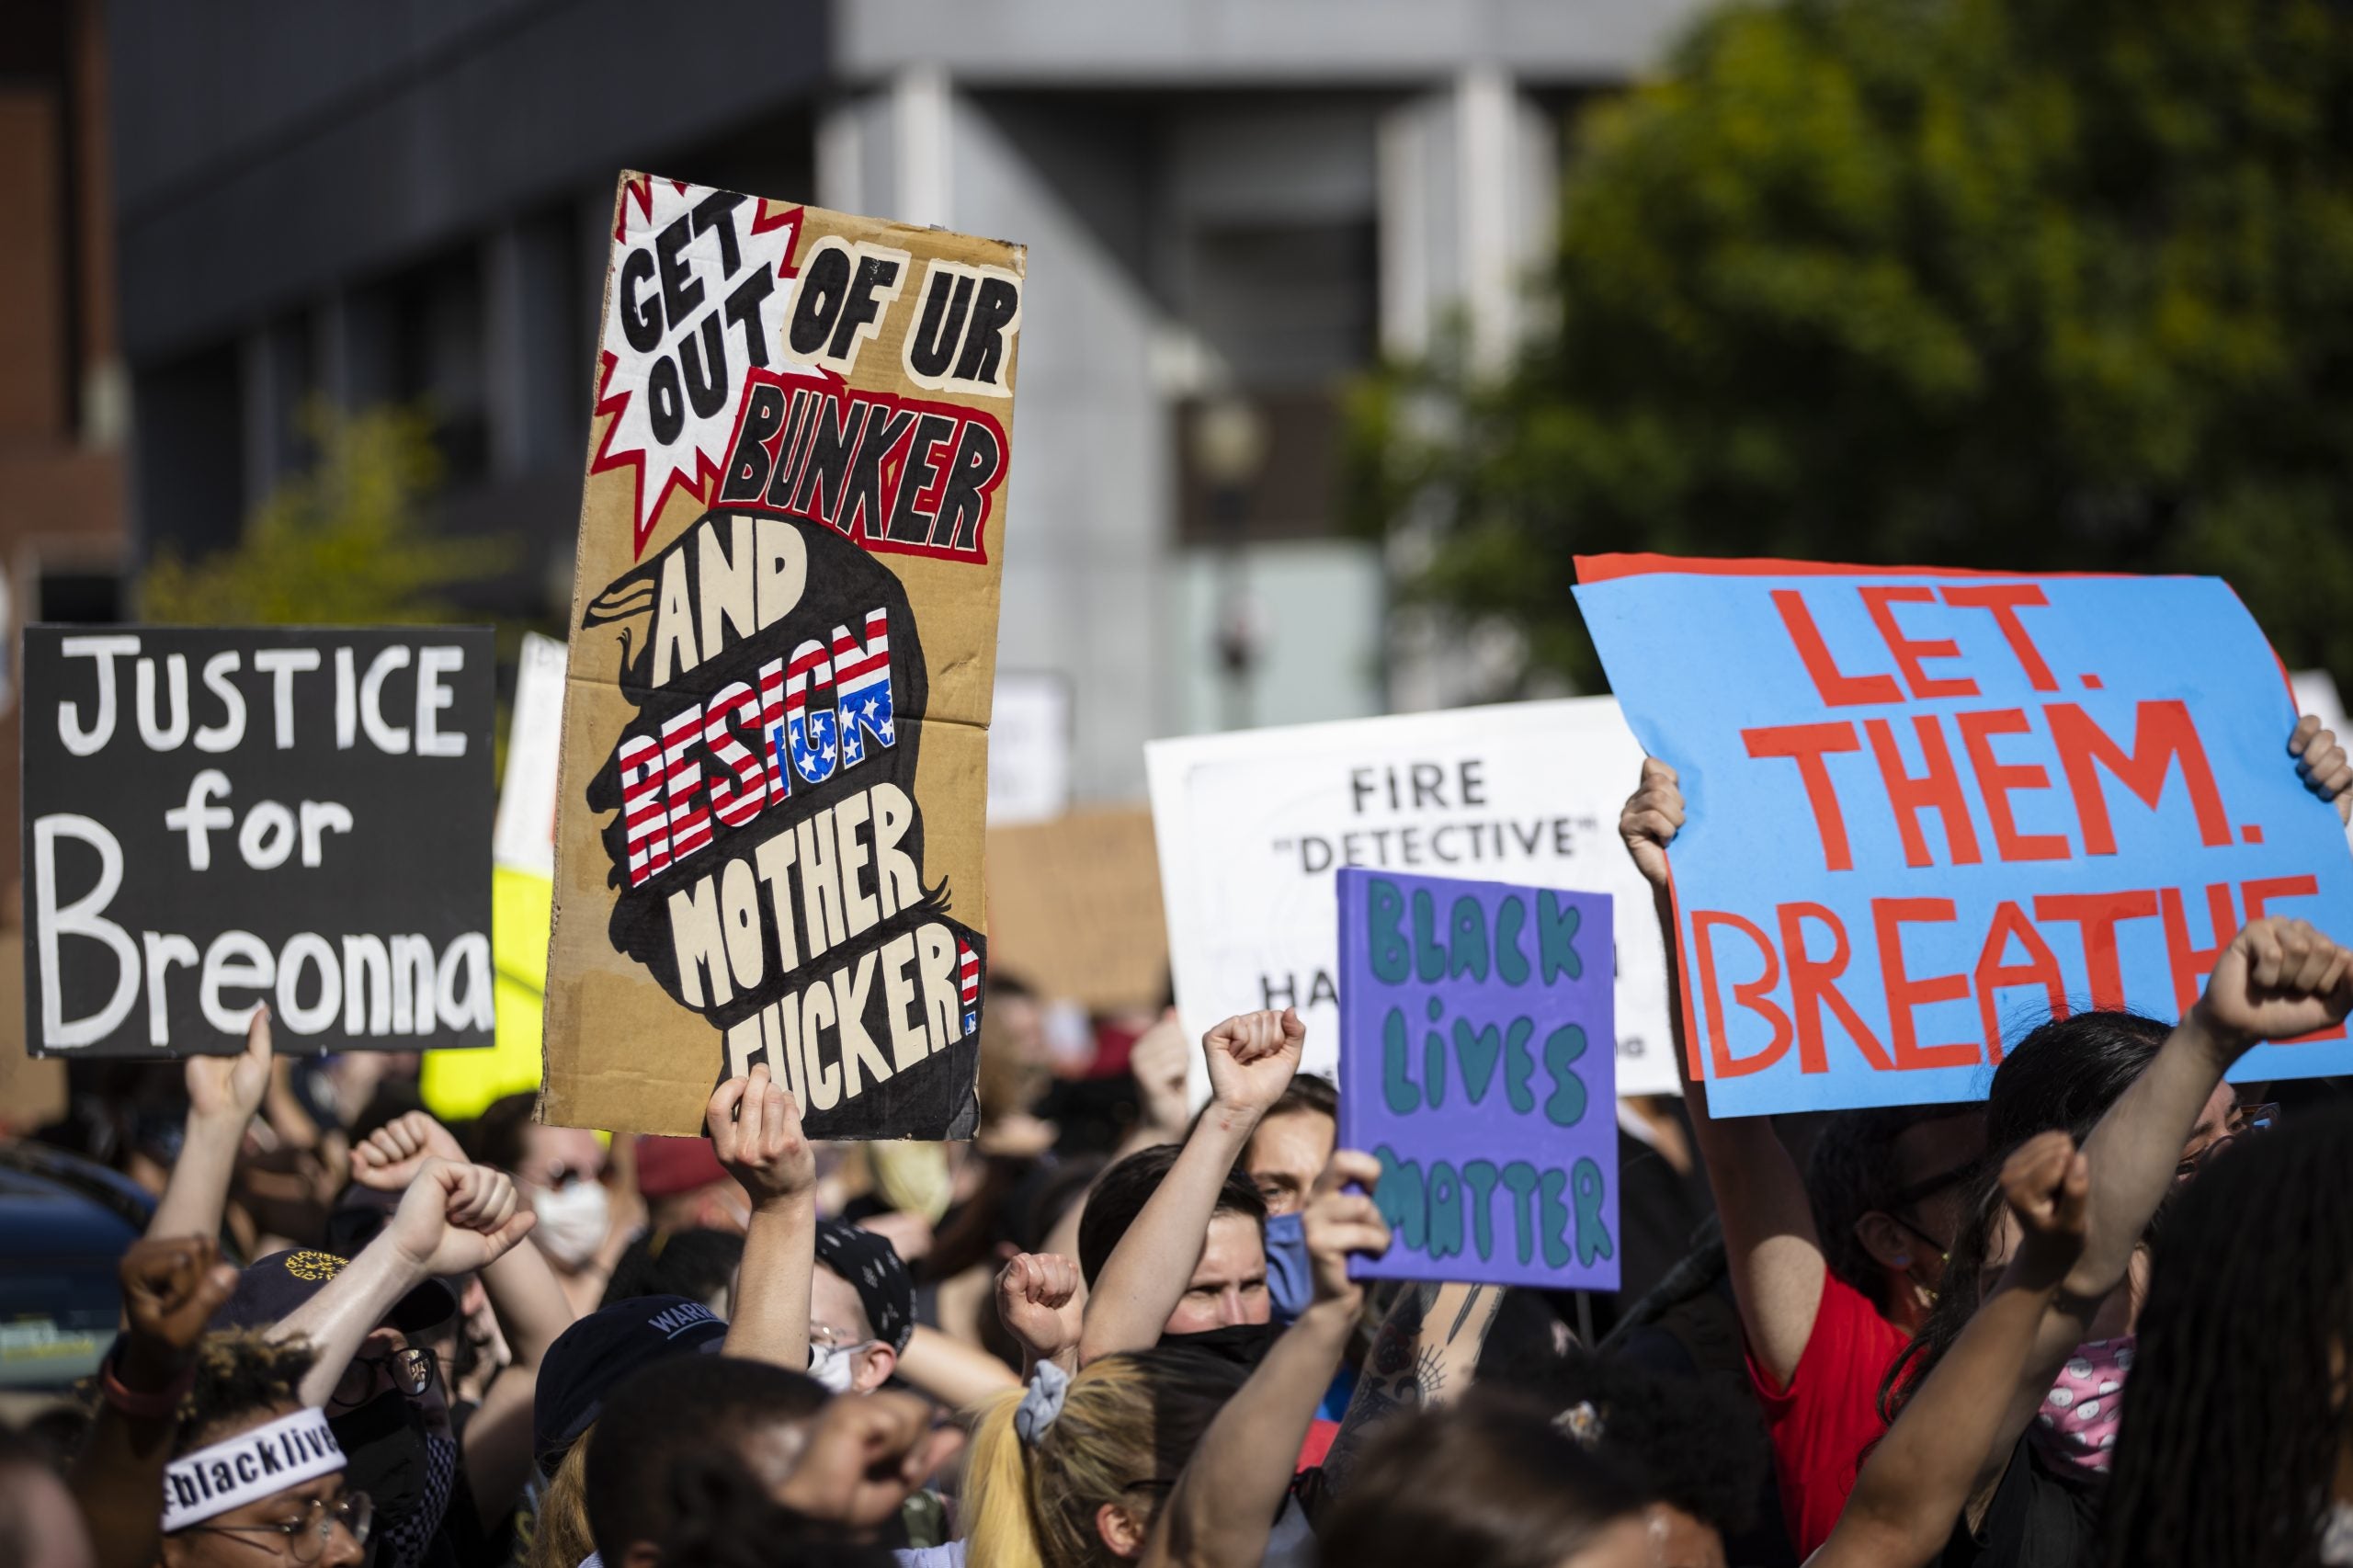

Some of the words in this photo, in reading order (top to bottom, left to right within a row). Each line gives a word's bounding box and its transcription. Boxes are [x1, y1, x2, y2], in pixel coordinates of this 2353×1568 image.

[620, 189, 748, 354] GET
[789, 247, 901, 360] OF
[909, 271, 1018, 385] UR
[648, 262, 775, 446] OUT
[718, 381, 1001, 551] BUNKER
[651, 515, 808, 688] AND
[1769, 583, 2105, 708] LET.
[58, 634, 468, 756] JUSTICE
[618, 607, 893, 888] RESIGN
[165, 768, 354, 871] for
[1272, 816, 1597, 874] "DETECTIVE"
[1349, 759, 1487, 813] FIRE
[1739, 699, 2265, 872] THEM.
[34, 813, 494, 1049] Breonna
[667, 782, 924, 1007] MOTHER
[1368, 877, 1584, 987] BLACK
[1371, 1144, 1614, 1269] MATTER
